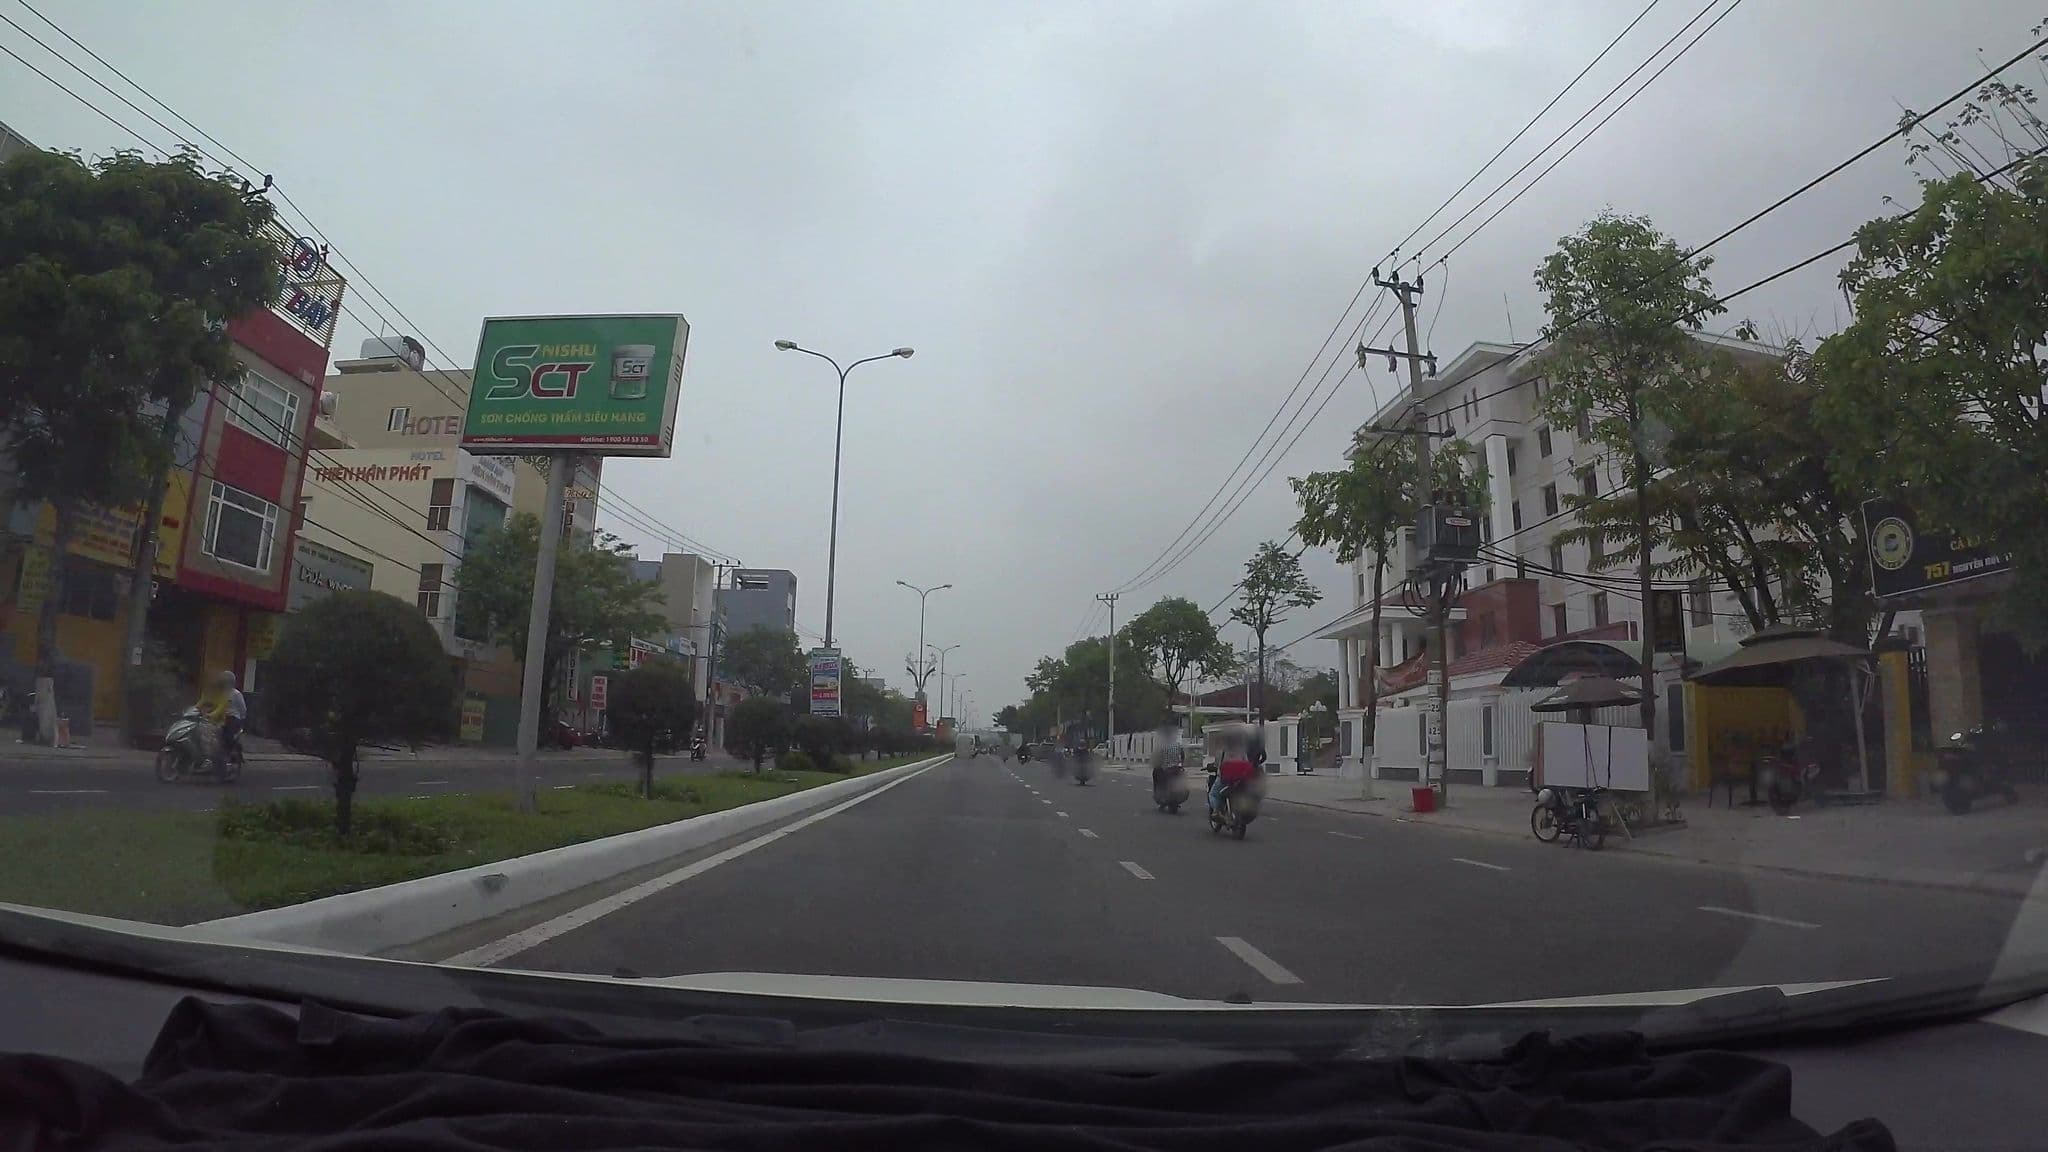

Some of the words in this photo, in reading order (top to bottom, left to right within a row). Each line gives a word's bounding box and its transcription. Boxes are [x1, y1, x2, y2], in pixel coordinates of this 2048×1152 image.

[542, 343, 597, 357] NISHU
[505, 410, 547, 424] CHỐNG
[585, 410, 609, 423] SIÊU
[389, 463, 432, 481] PHÁT
